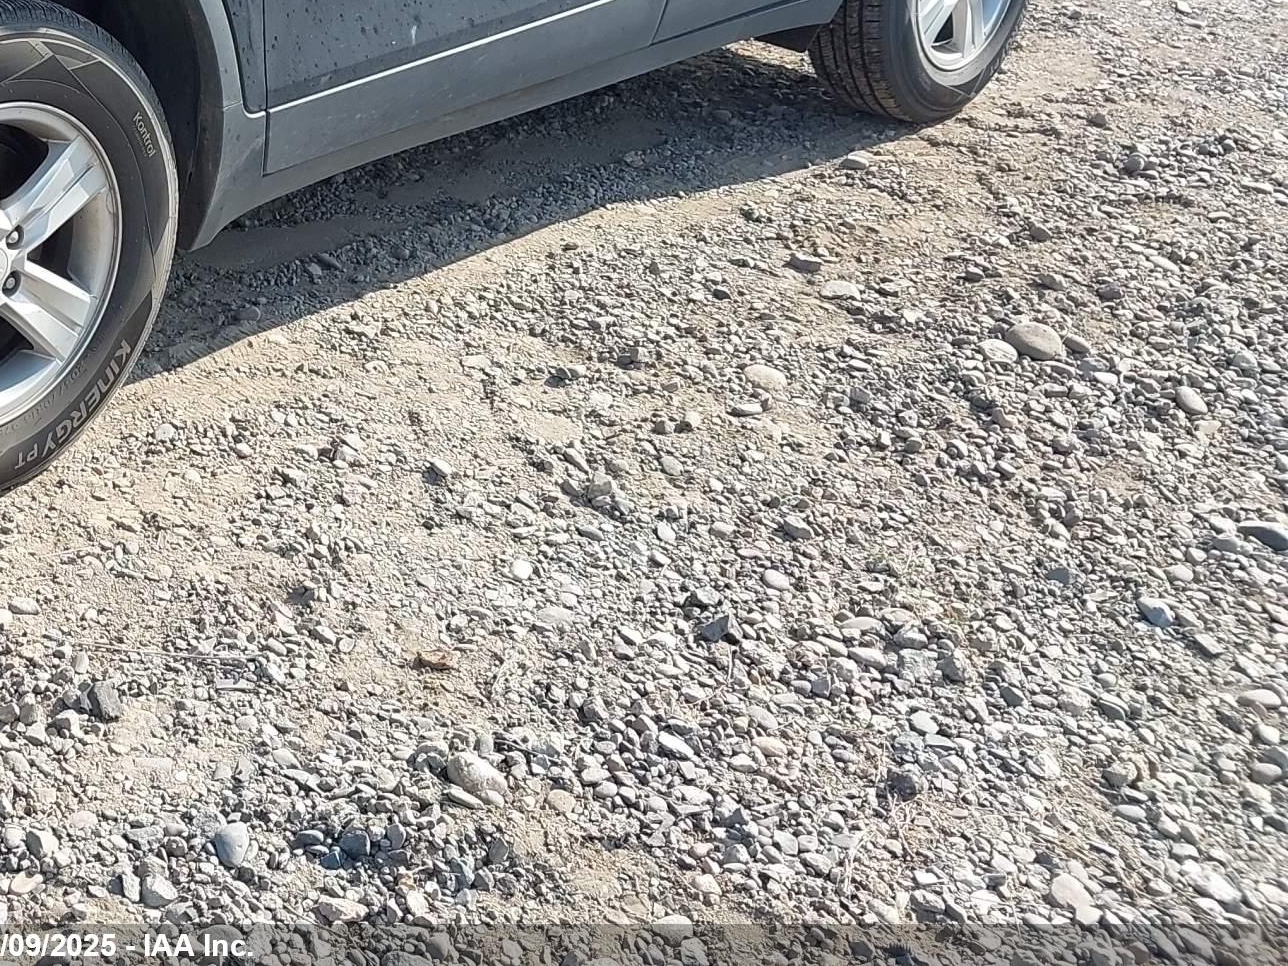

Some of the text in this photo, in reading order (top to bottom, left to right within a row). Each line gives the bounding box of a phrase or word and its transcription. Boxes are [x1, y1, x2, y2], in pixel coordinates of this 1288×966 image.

[132, 111, 157, 158] Kontrol
[14, 338, 132, 470] KINERGY PT
